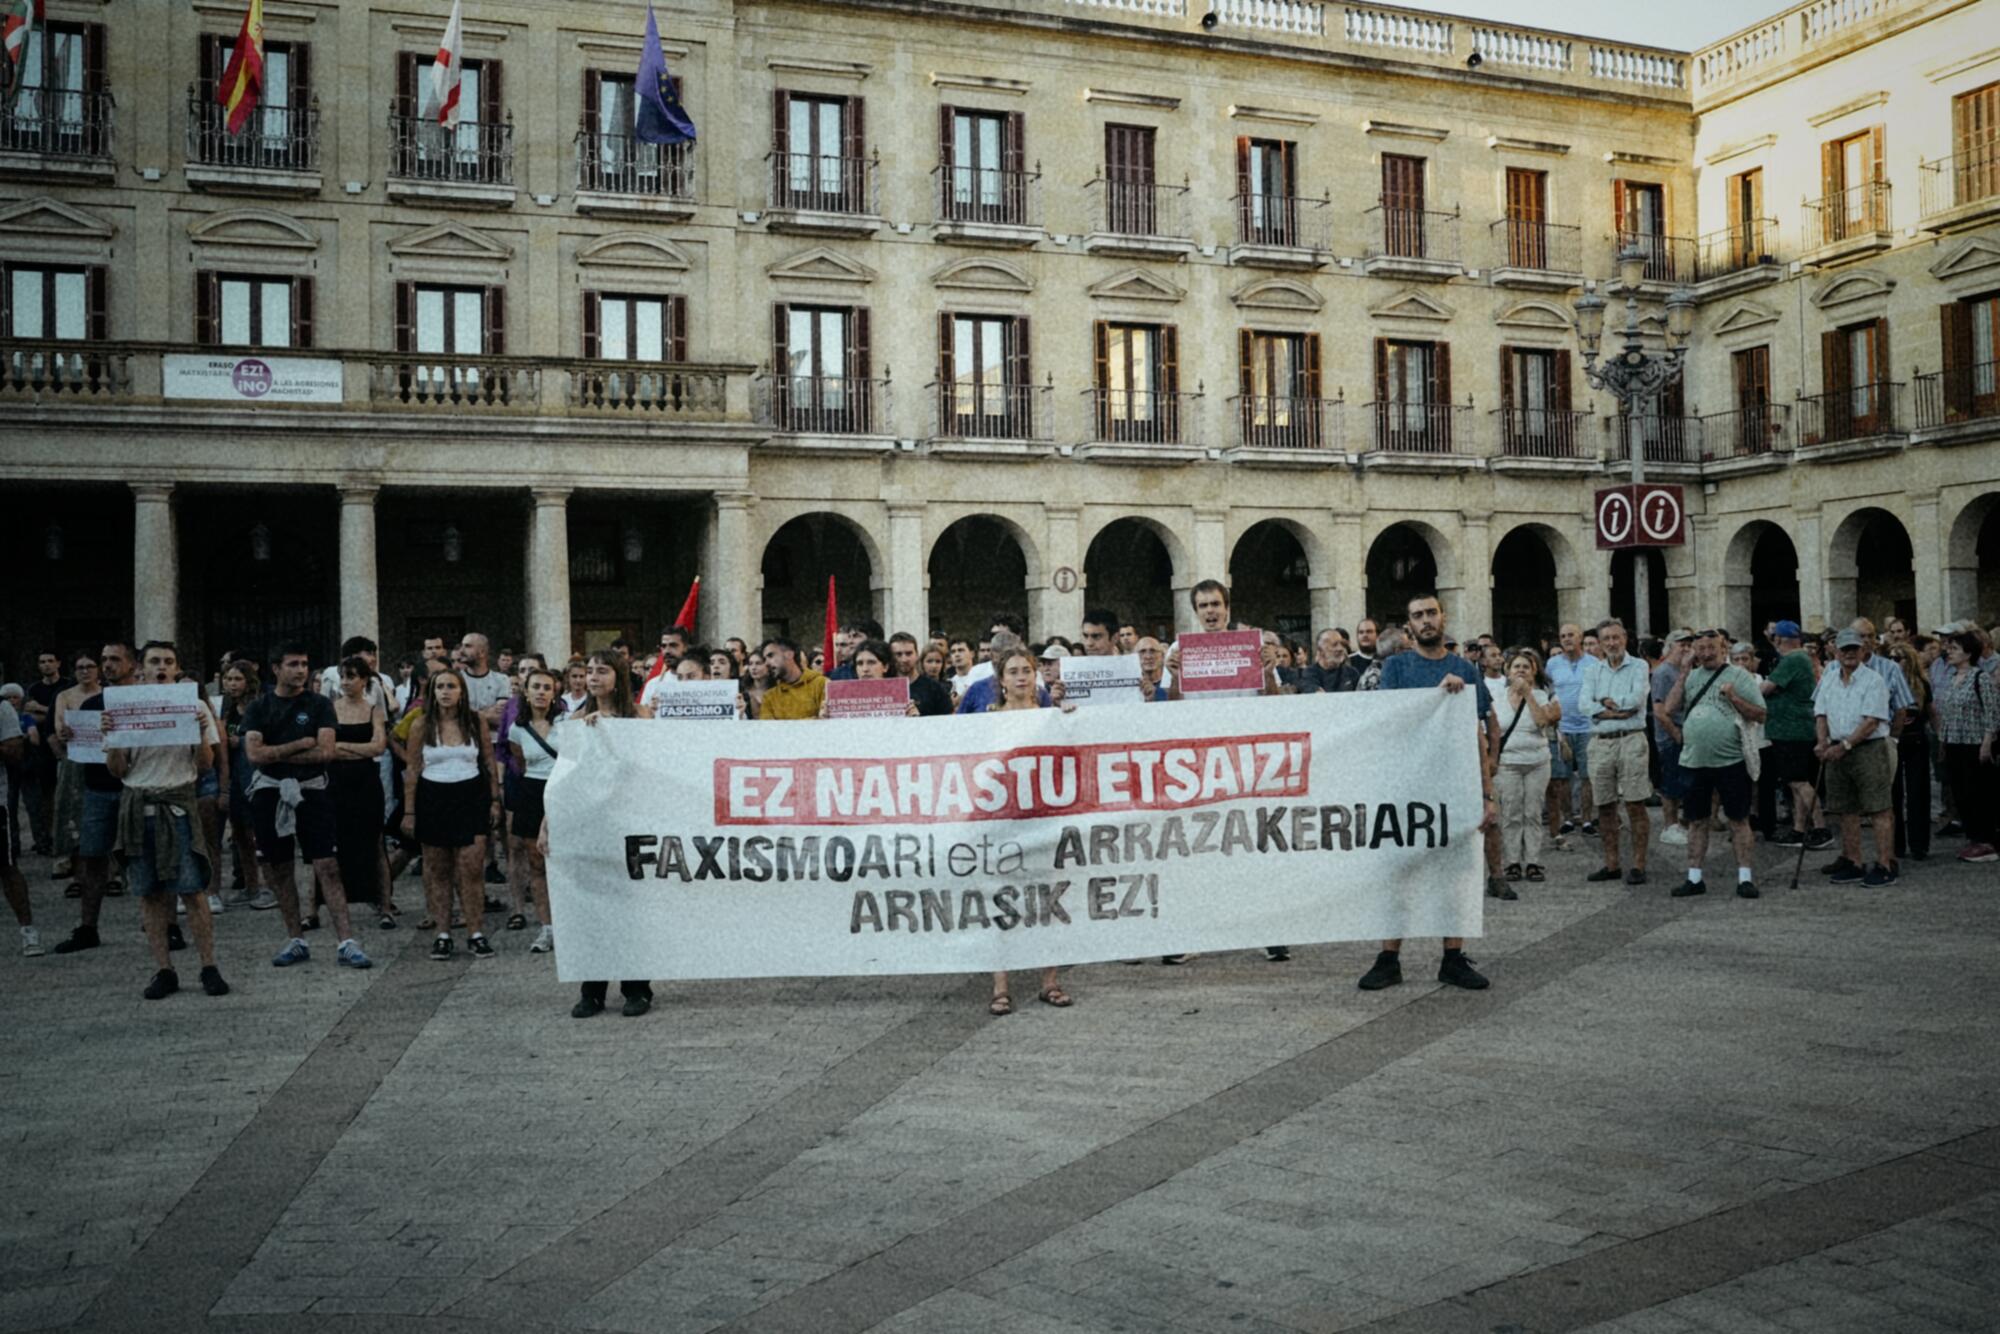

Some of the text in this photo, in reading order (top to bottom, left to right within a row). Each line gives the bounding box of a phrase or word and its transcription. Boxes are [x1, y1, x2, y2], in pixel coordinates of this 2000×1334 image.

[208, 361, 235, 369] ERASO
[240, 364, 264, 377] EZ!
[238, 380, 268, 393] ¡NO
[1064, 671, 1076, 680] EZ
[662, 705, 732, 717] FASCISMO Y
[728, 741, 1302, 819] EZ NAHASTU ETSAIZ!
[625, 802, 1448, 883] FAXISMOARI eta ARRAZAKERIARI
[850, 873, 1159, 934] ARNASIK EZ!
